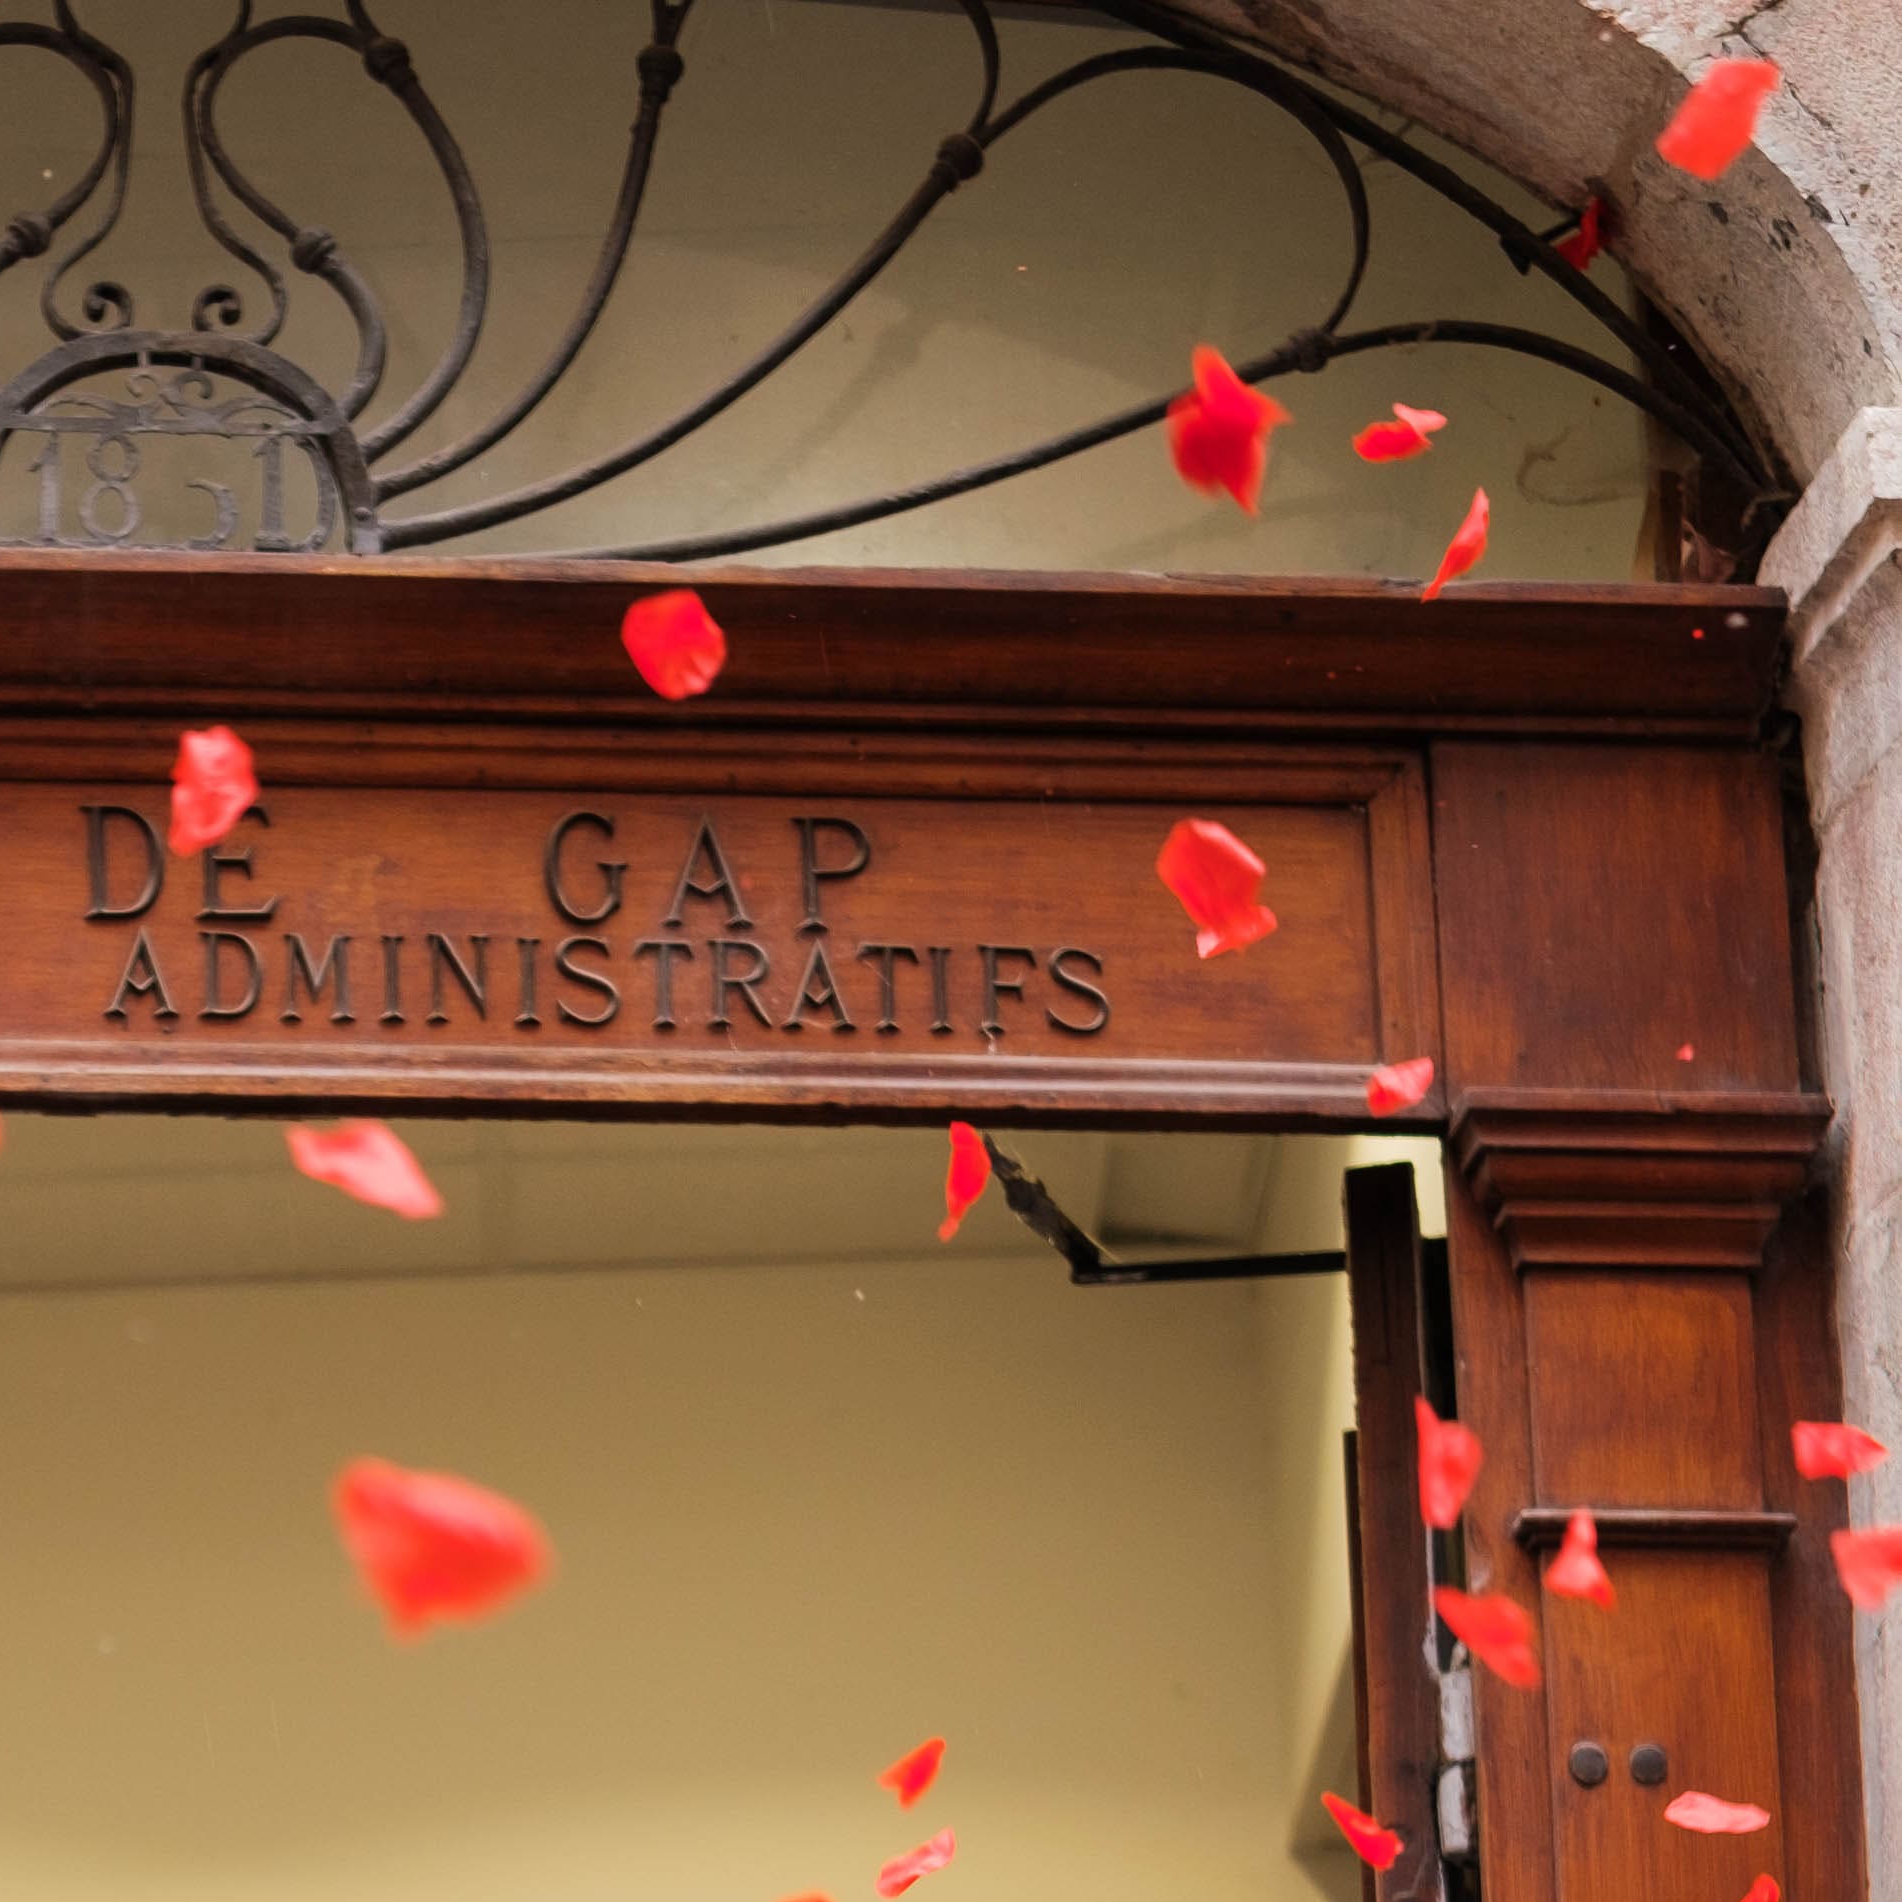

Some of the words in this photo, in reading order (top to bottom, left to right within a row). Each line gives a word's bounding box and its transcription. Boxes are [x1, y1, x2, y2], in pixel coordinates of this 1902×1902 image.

[78, 804, 284, 924] DE
[543, 811, 872, 935] GAP
[103, 924, 1114, 1036] ADMINISTRATIFS
